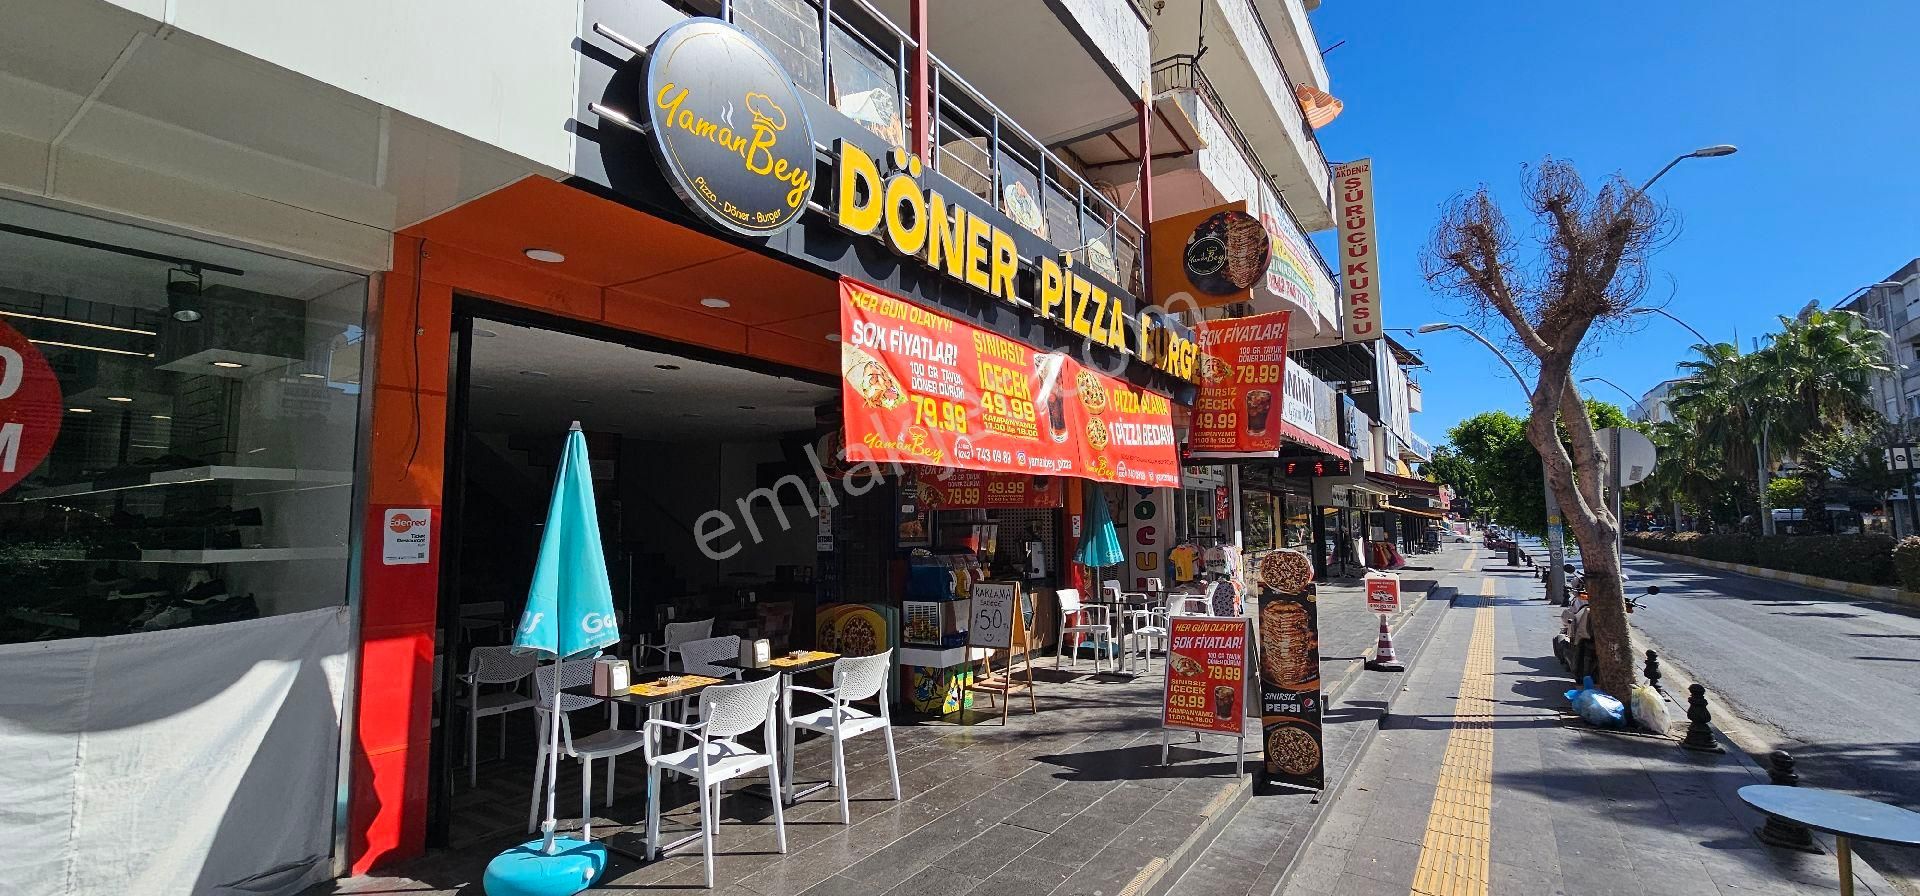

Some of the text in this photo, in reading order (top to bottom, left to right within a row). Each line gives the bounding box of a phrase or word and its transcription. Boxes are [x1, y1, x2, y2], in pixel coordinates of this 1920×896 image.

[657, 83, 811, 208] YamanBey
[1336, 165, 1369, 178] AKDENİZ
[695, 176, 781, 224] Pizza Döner Burger
[839, 140, 1018, 305] DÖNER
[1042, 252, 1127, 354] PİZZA
[1344, 178, 1373, 335] SÜRÜCÜ KURSU
[850, 290, 877, 313] HER
[910, 308, 953, 333] OLAYYY!
[852, 319, 957, 366] ŞOK FİYATLAR!
[1198, 322, 1285, 348] ŞOK FİYATLAR!
[1263, 345, 1282, 354] TAVUK
[910, 361, 925, 376] 100
[928, 365, 938, 379] GR
[1236, 365, 1280, 384] 79.99
[982, 392, 1036, 422] 49.99
[1114, 385, 1140, 413] PİZZA
[911, 395, 967, 433] 79.99
[1196, 413, 1237, 429] 49.99
[984, 422, 1005, 434] 11.00
[1017, 427, 1039, 437] 18.00
[1109, 422, 1116, 445] 1
[1116, 417, 1143, 445] PİZZA
[976, 448, 990, 462] 743
[948, 488, 980, 505] 79.99
[988, 482, 1025, 494] 49.99
[390, 519, 426, 527] Edenred
[980, 609, 1002, 630] 50
[1175, 622, 1244, 632] HER GÜN OLAYYY!
[1173, 634, 1243, 651] ŞOK FİYATLAR!
[1207, 665, 1241, 680] 79.99
[1171, 679, 1207, 687] SINIRSIZ
[1169, 694, 1206, 708] 49.99
[1264, 692, 1296, 701] SINIRSIZ
[1168, 707, 1214, 718] KAMPANYAMIZ
[1265, 703, 1301, 713] PEPSI
